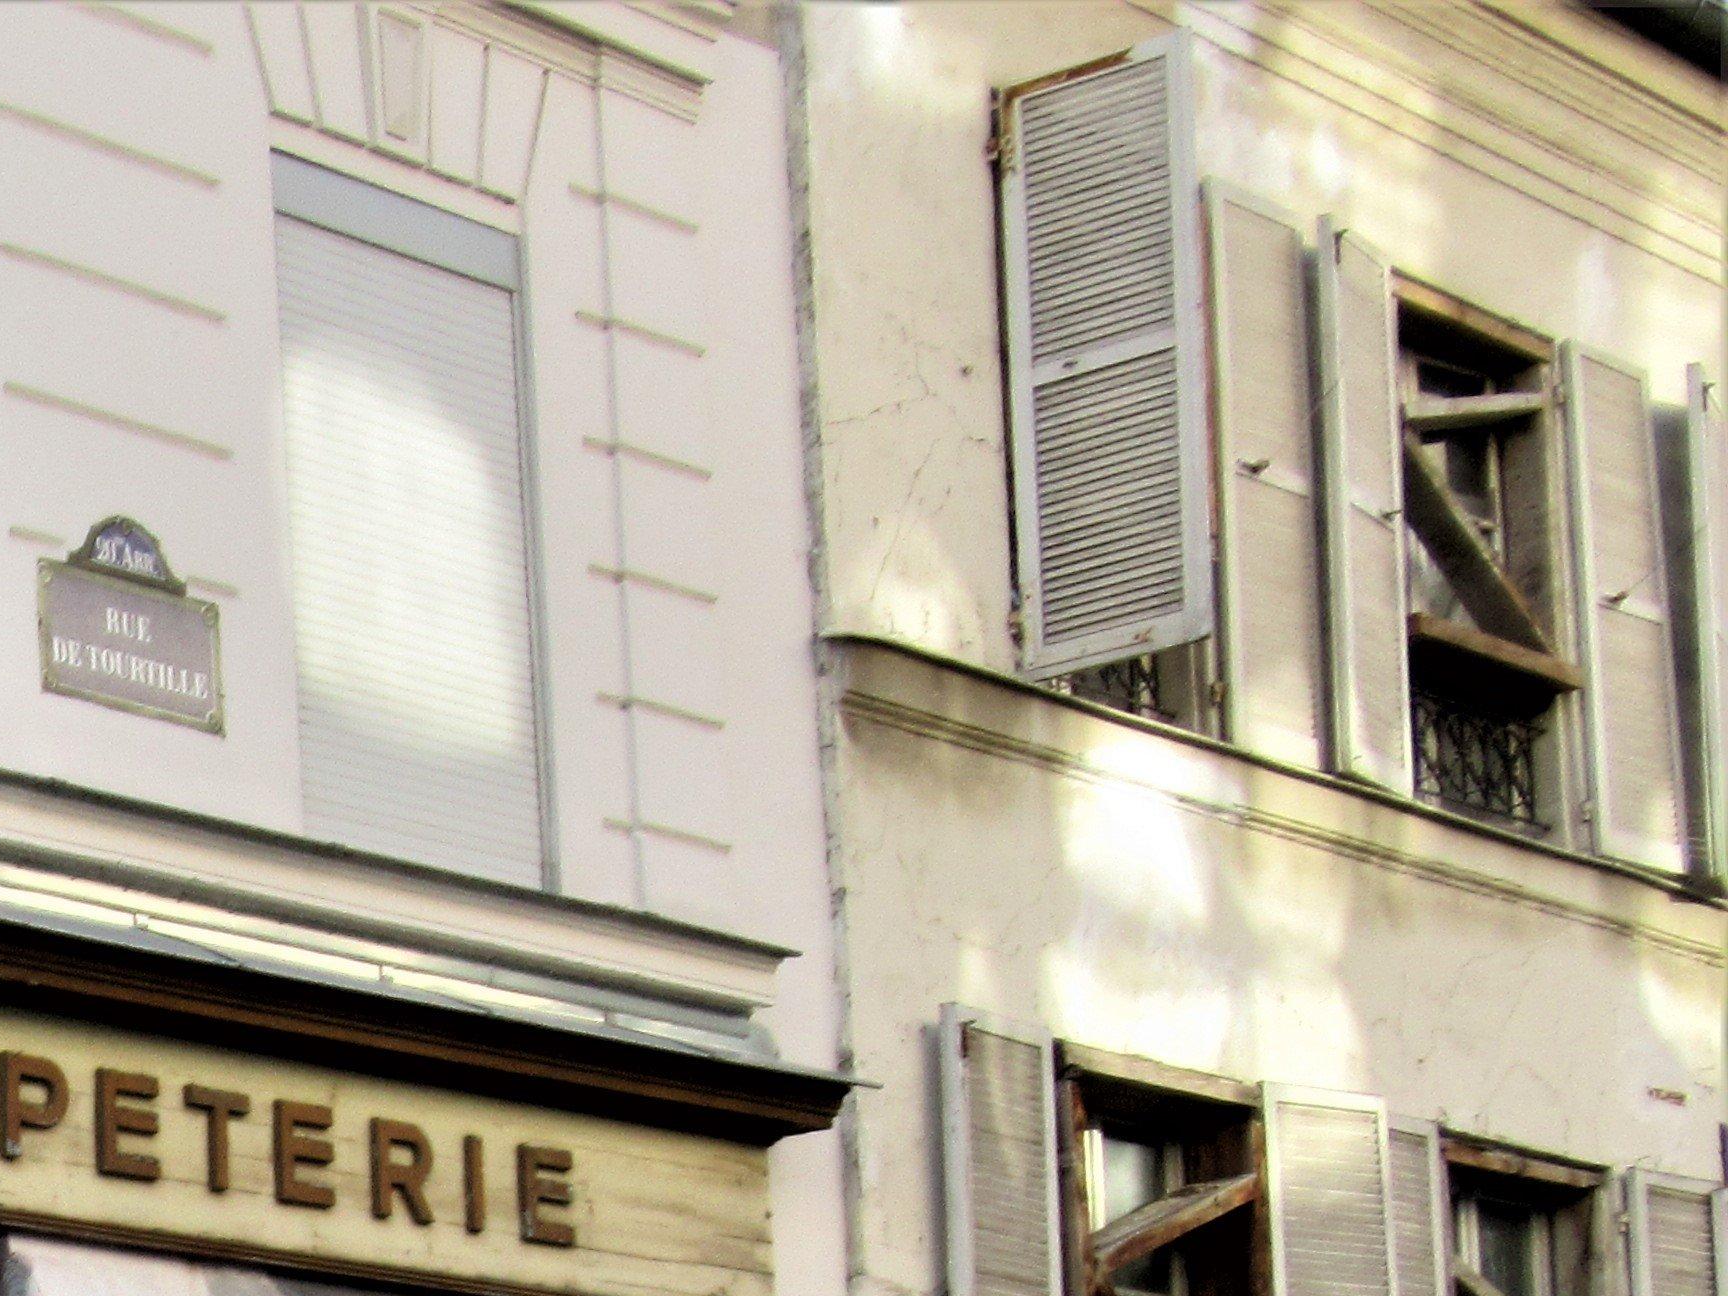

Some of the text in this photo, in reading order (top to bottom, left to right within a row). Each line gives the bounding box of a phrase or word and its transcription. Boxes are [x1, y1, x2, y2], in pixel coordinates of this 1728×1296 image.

[105, 606, 152, 643] RUE
[51, 634, 209, 700] DE TOURTILLE
